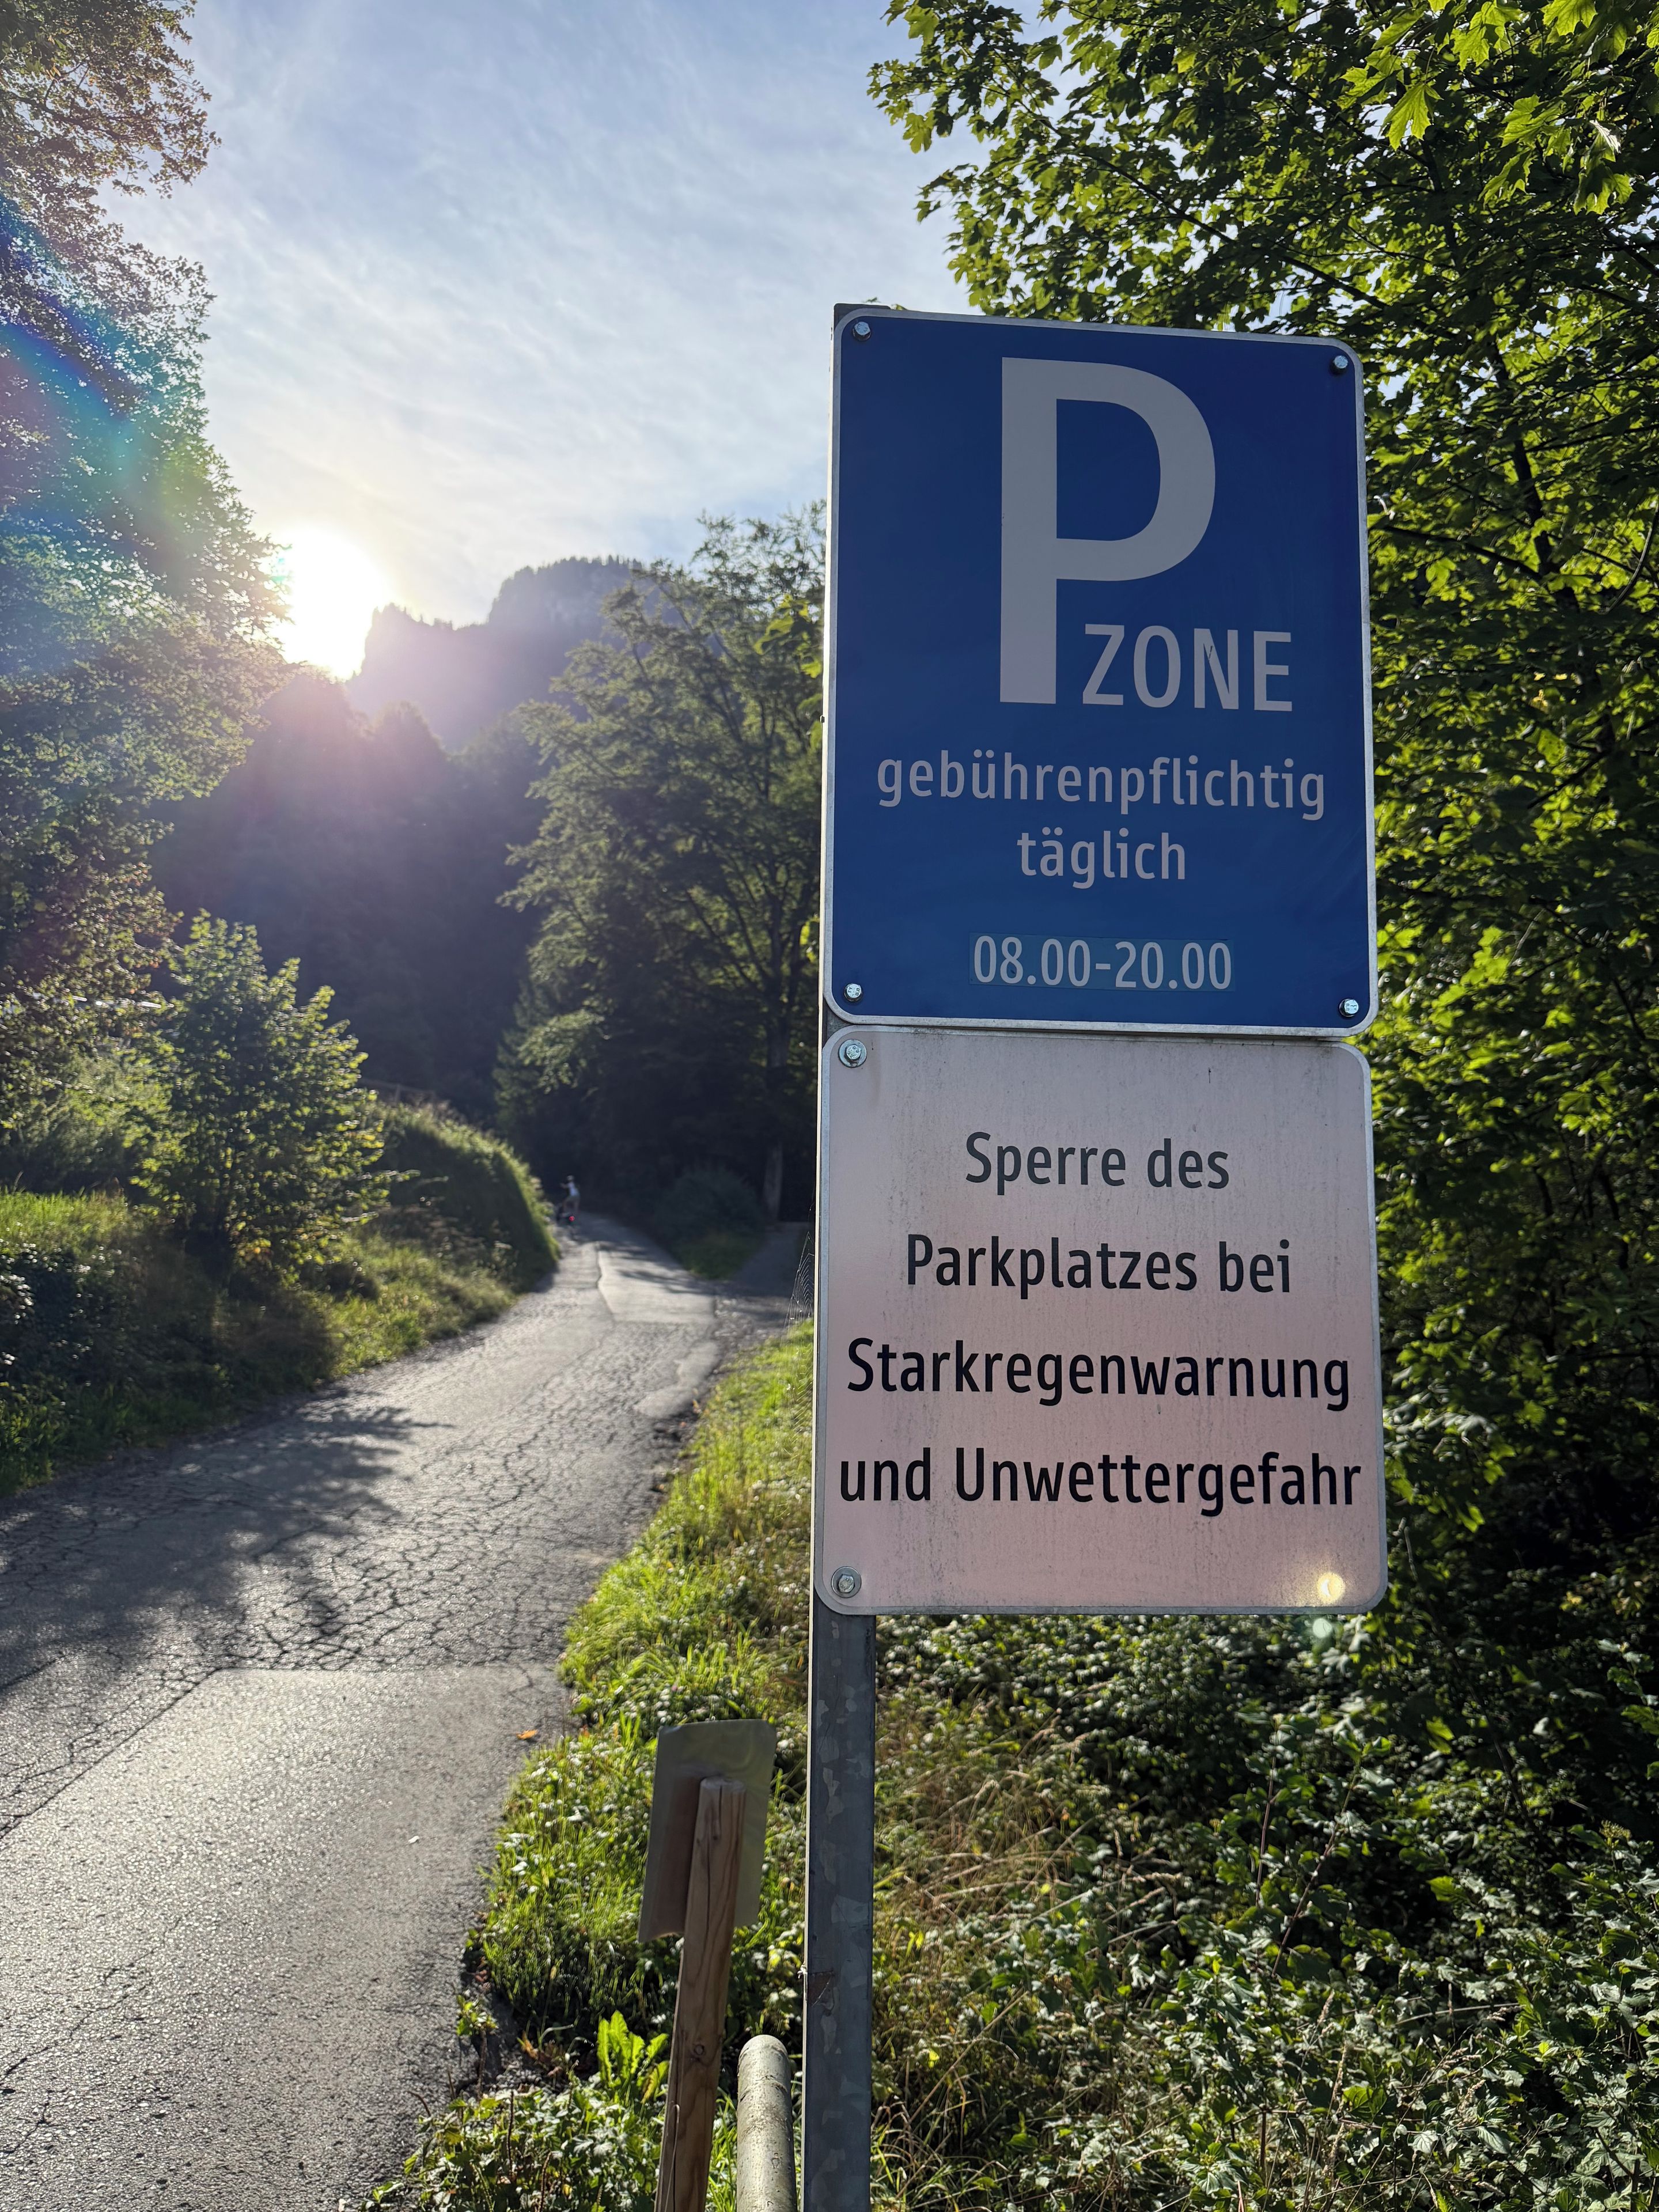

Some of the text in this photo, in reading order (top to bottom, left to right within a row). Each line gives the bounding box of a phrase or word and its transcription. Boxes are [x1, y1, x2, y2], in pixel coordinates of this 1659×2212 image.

[999, 357, 1215, 705] P
[1082, 623, 1293, 712] ZONE
[877, 749, 1324, 821] gebührenpflichtig
[1017, 827, 1185, 889] täglich
[974, 935, 1232, 990] 08.00-20.00
[965, 1131, 1230, 1196] Sperre des
[907, 1234, 1290, 1300] Parkplatzes bei
[847, 1337, 1350, 1412] Starkregenwarnung
[840, 1447, 1362, 1517] und Unwettergefahr
